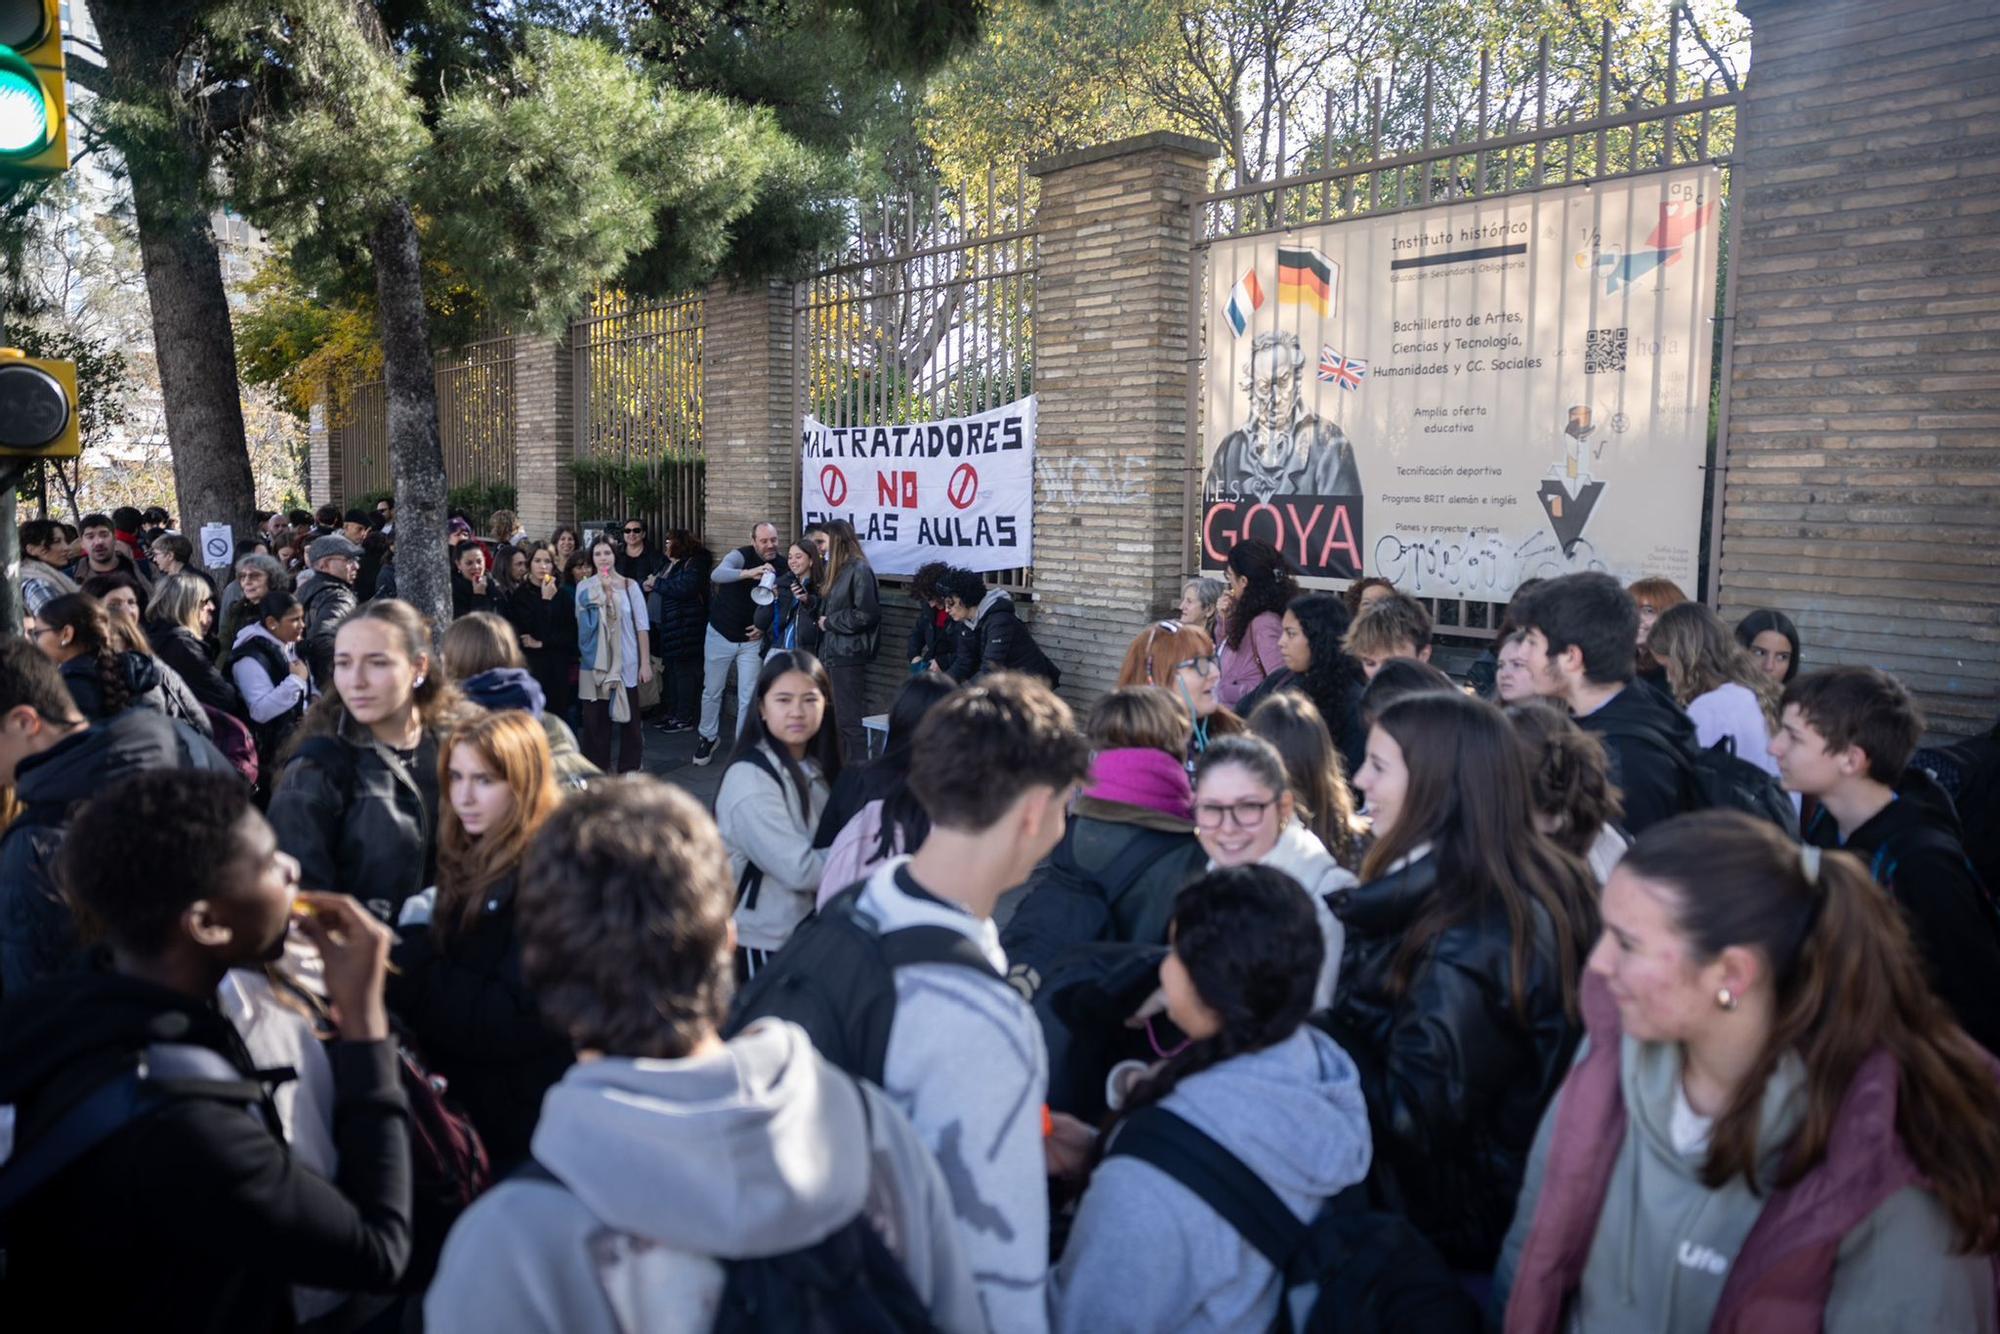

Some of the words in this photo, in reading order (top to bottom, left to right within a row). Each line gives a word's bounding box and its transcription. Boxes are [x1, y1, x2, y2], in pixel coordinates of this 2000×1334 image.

[1391, 231, 1453, 251] Instituto
[1460, 221, 1528, 242] histórico
[1393, 317, 1462, 333] Bachillerato
[1466, 314, 1481, 326] de
[1484, 311, 1524, 326] Artes,
[1392, 341, 1439, 354] Ciencias
[1443, 341, 1452, 354] y
[1454, 333, 1523, 352] Tecnología,
[1373, 362, 1449, 377] Humanidades
[1453, 362, 1462, 375] y
[1466, 360, 1486, 373] CC.
[1490, 356, 1543, 371] Sociales
[1414, 407, 1449, 420] Amplia
[1452, 405, 1487, 417] oferta
[804, 417, 1022, 458] MALTRATADORES
[1423, 423, 1475, 434] educativa
[1396, 464, 1454, 477] Tecnificación
[1456, 465, 1503, 478] deportiva
[876, 470, 919, 509] NO
[1205, 479, 1246, 503] I.E.S.
[1382, 493, 1421, 506] Programa
[1448, 493, 1479, 505] alemán
[1490, 494, 1518, 508] inglés
[849, 513, 899, 541] LAS
[917, 516, 1017, 547] AULAS
[1204, 502, 1362, 570] GOYA
[1395, 522, 1421, 533] Planes
